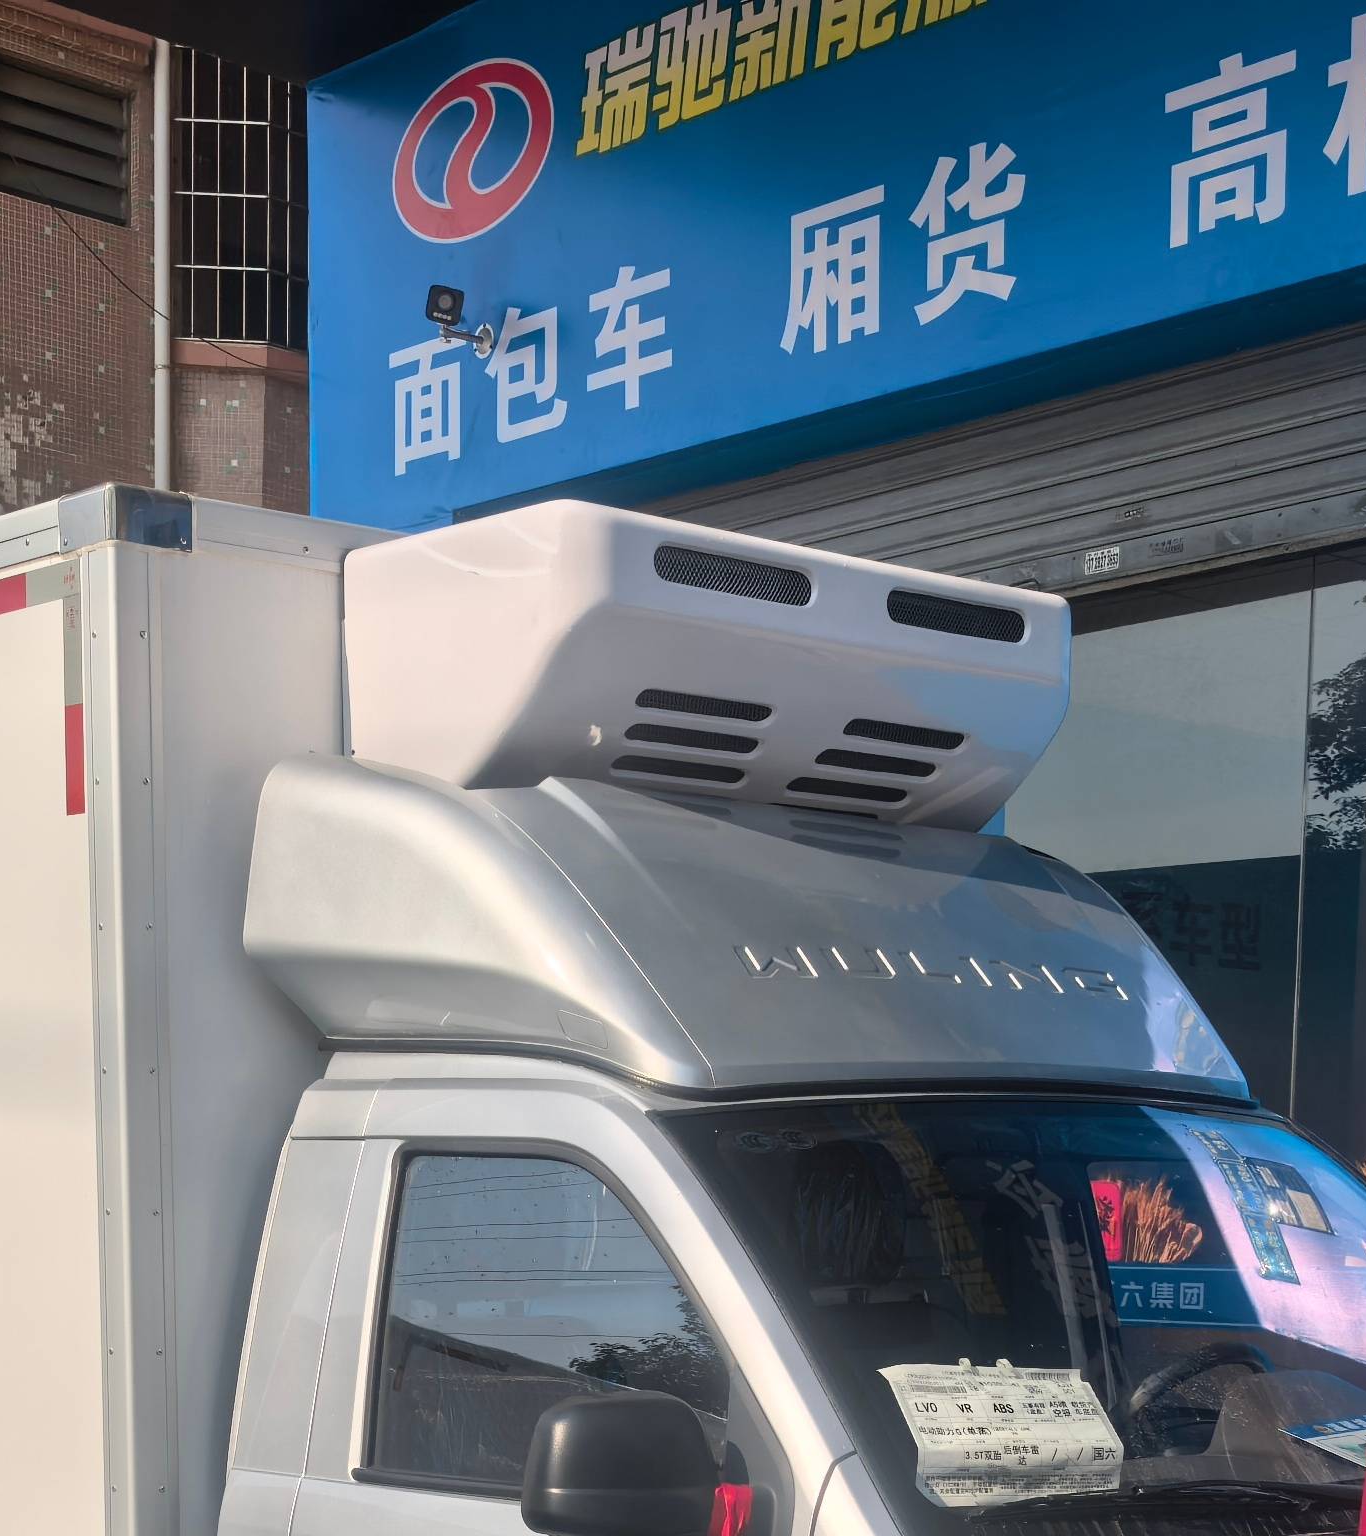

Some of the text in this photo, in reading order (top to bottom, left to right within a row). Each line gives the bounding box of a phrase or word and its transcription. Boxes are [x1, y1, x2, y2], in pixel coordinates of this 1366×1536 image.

[576, 0, 988, 156] 瑞驰新能
[389, 266, 673, 477] 面包车
[781, 142, 1026, 354] 厢货
[733, 945, 1129, 1001] WULING
[1112, 1281, 1205, 1310] 六集团
[993, 1403, 1015, 1414] ABS
[1093, 1448, 1117, 1460] 国六
